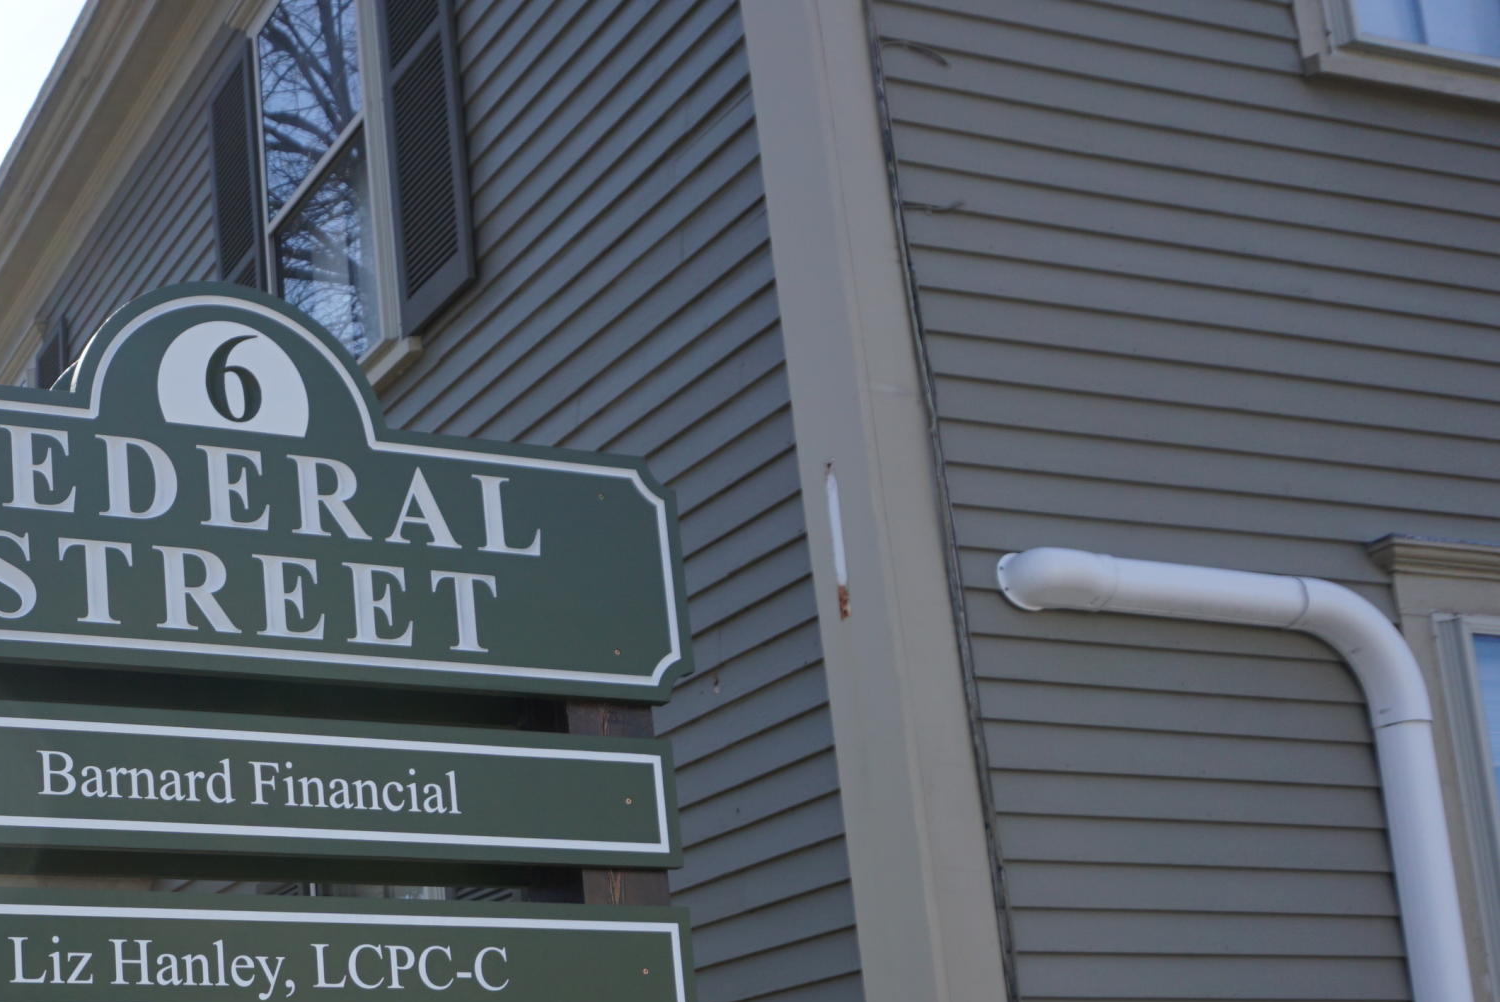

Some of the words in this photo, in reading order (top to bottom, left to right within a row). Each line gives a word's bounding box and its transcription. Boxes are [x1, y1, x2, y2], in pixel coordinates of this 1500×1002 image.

[204, 333, 263, 424] 6
[35, 749, 237, 805] Barnard
[247, 760, 463, 815] Financial
[7, 935, 94, 985] Liz
[107, 938, 296, 1001] Hanley,
[309, 943, 510, 992] LCPC-C
